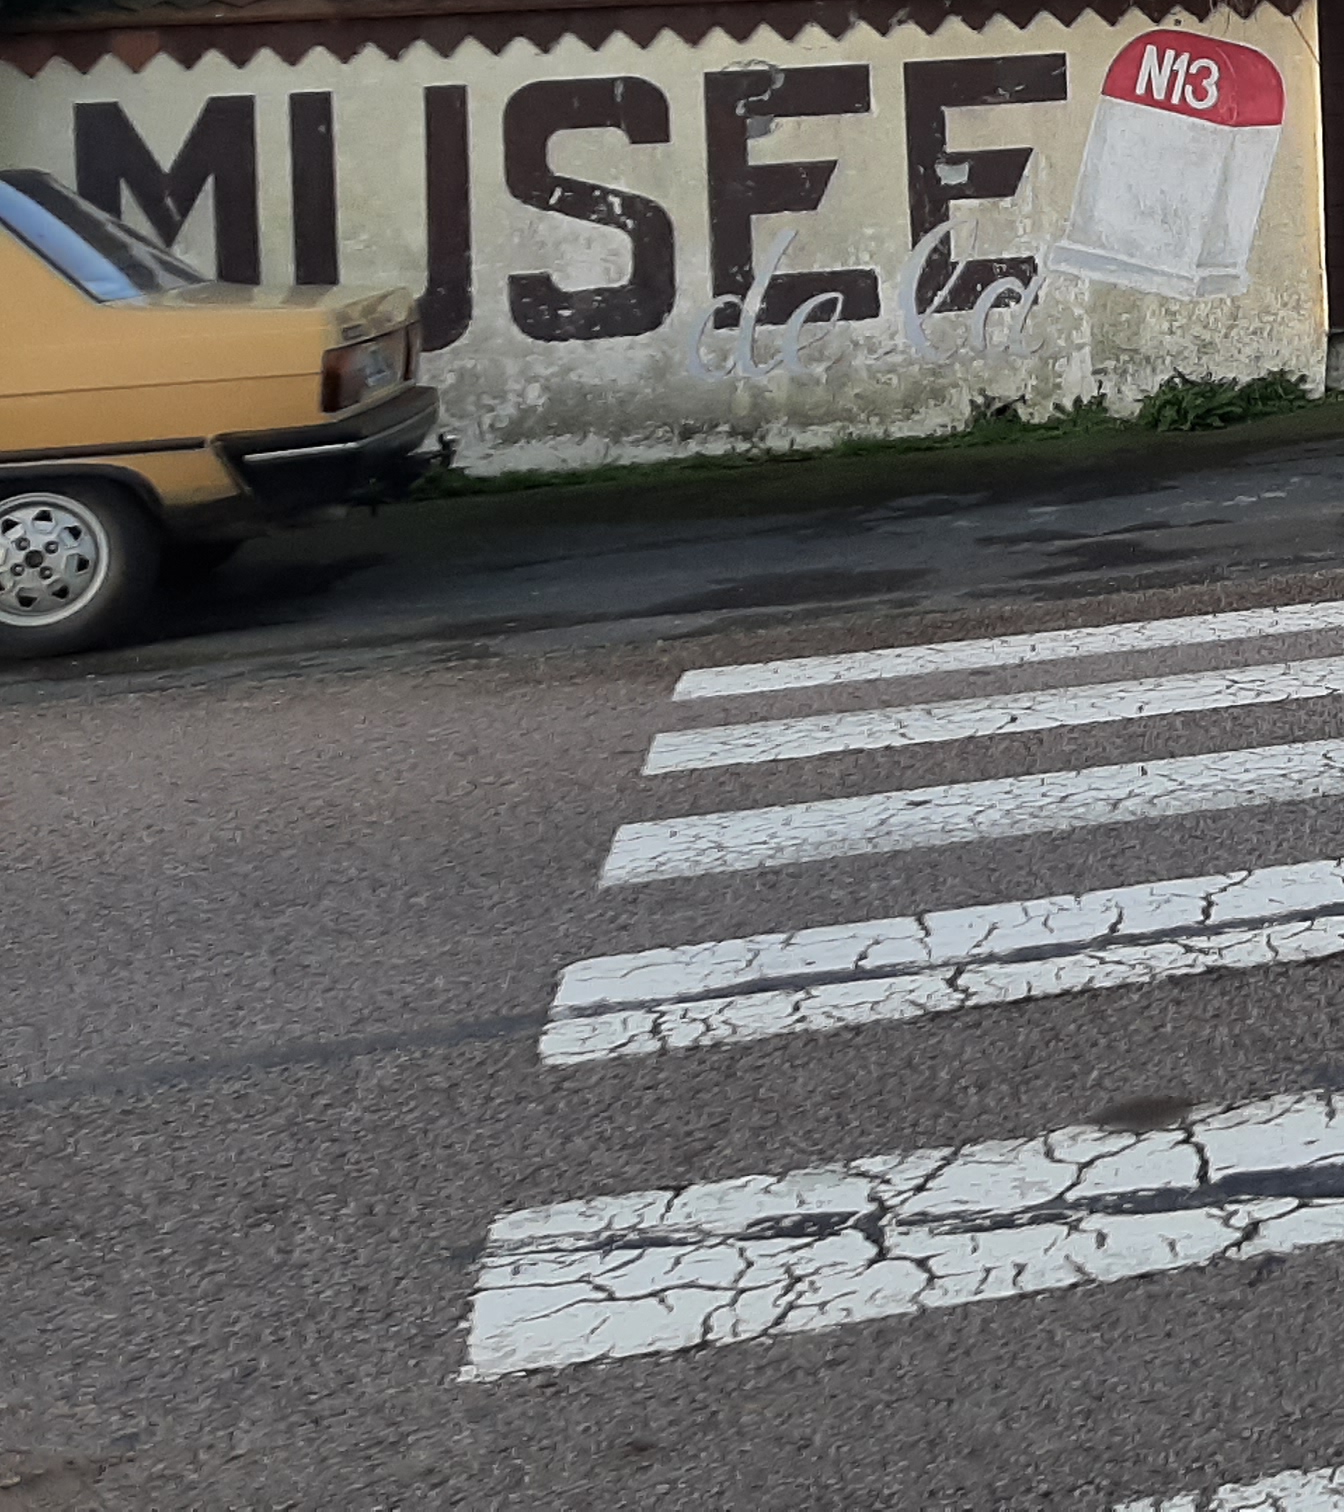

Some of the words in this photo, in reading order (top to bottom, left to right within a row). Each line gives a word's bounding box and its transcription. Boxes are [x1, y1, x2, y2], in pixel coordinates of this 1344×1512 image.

[1135, 44, 1220, 110] N13
[73, 52, 1068, 353] MUSEE
[688, 229, 849, 384] de
[899, 217, 1048, 361] la
